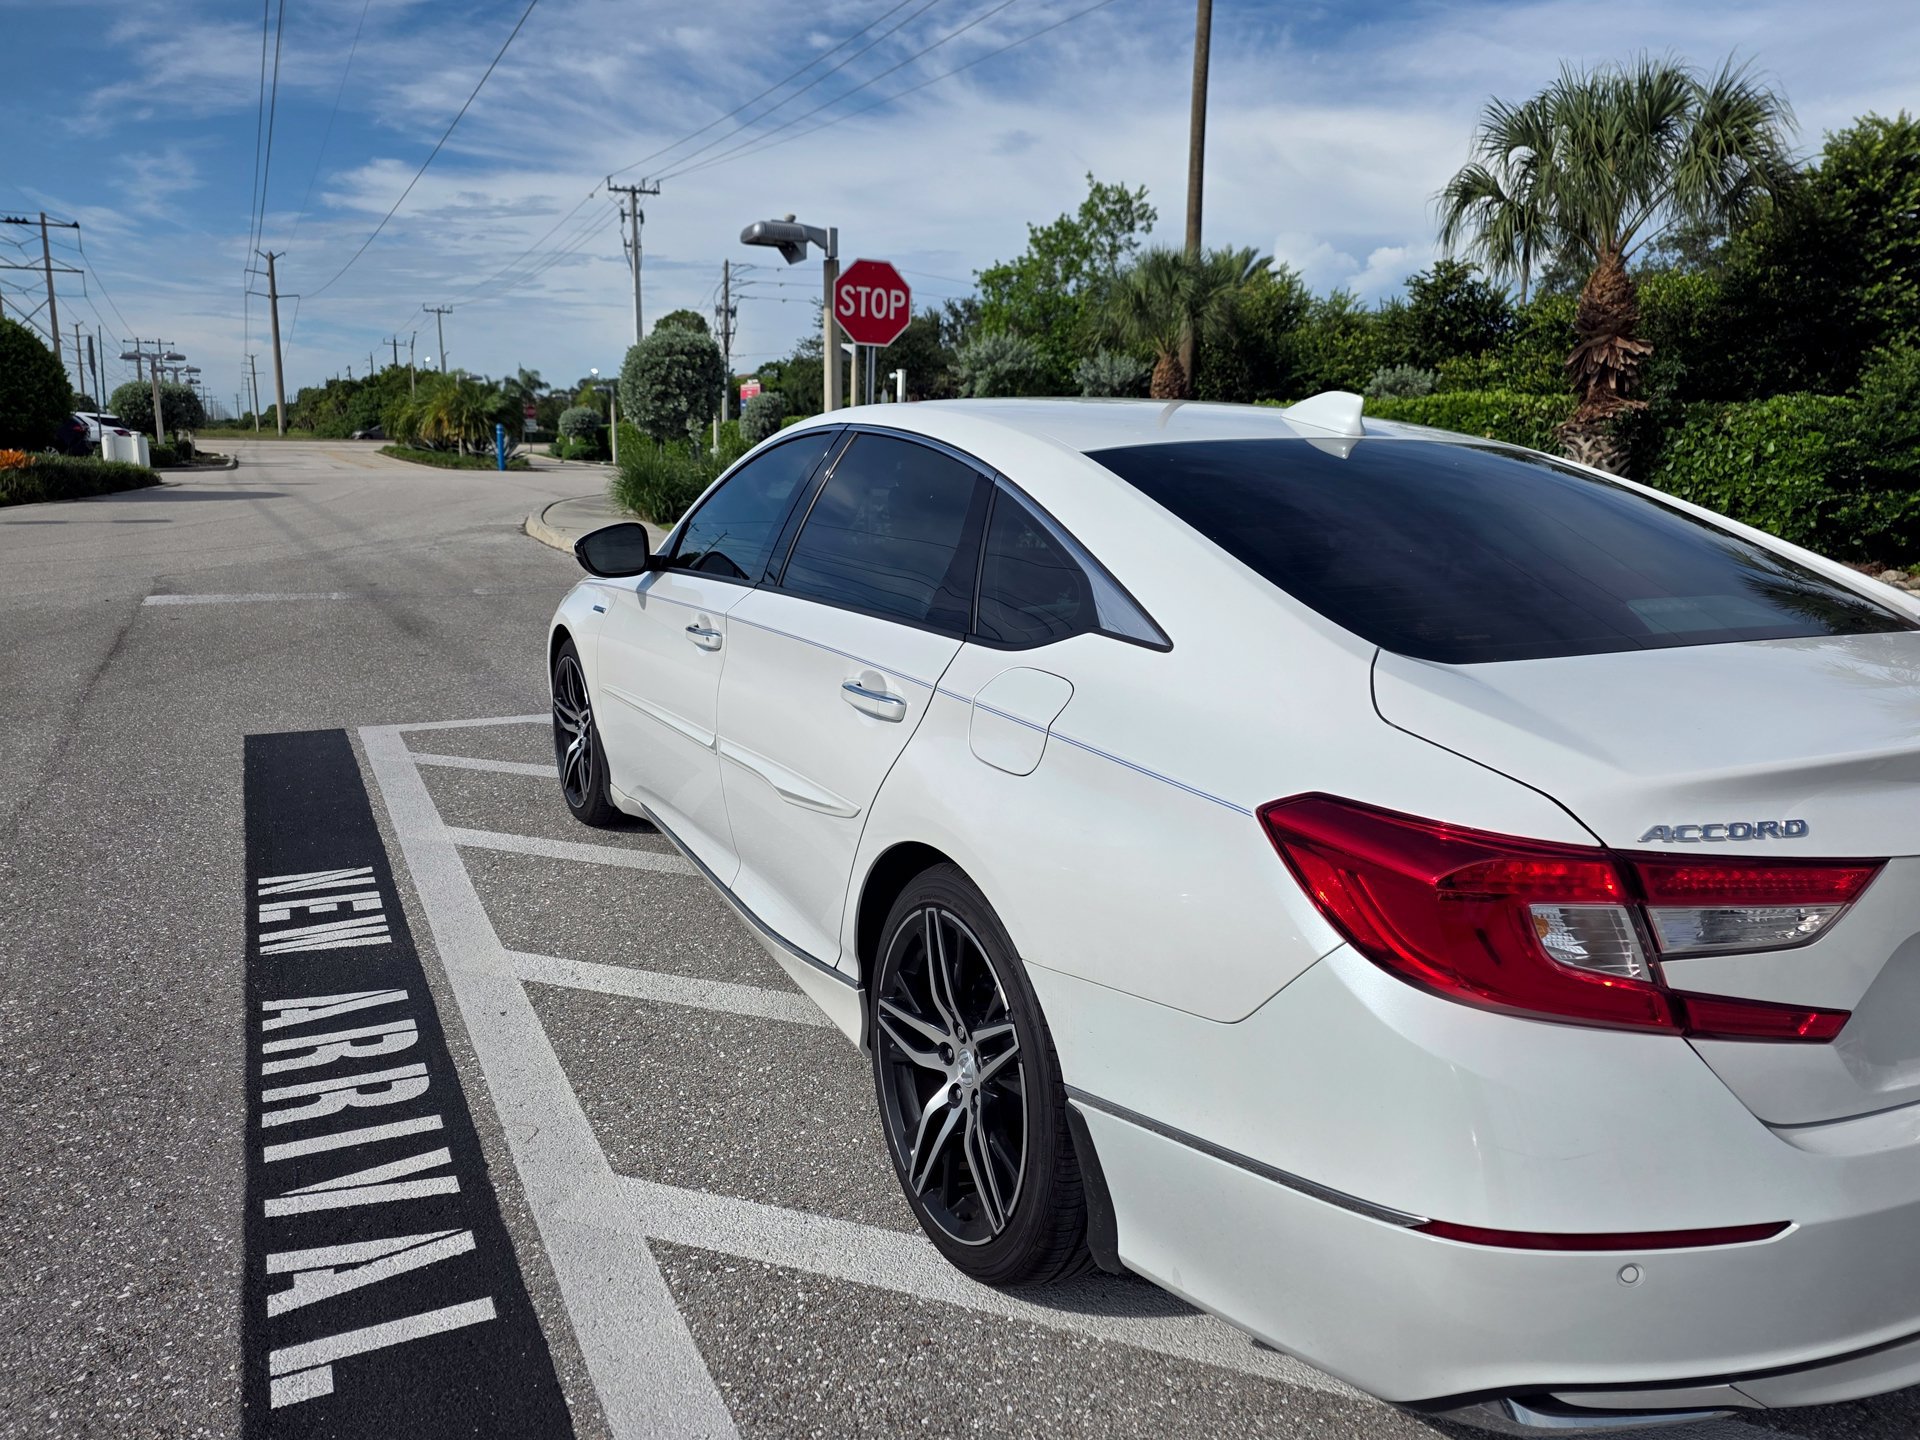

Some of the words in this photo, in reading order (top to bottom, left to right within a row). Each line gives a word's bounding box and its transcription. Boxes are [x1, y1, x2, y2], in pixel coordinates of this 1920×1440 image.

[839, 284, 906, 320] STOP
[1637, 819, 1810, 843] ACCORD
[257, 866, 392, 956] NEW
[261, 989, 497, 1410] ARRIVAL
